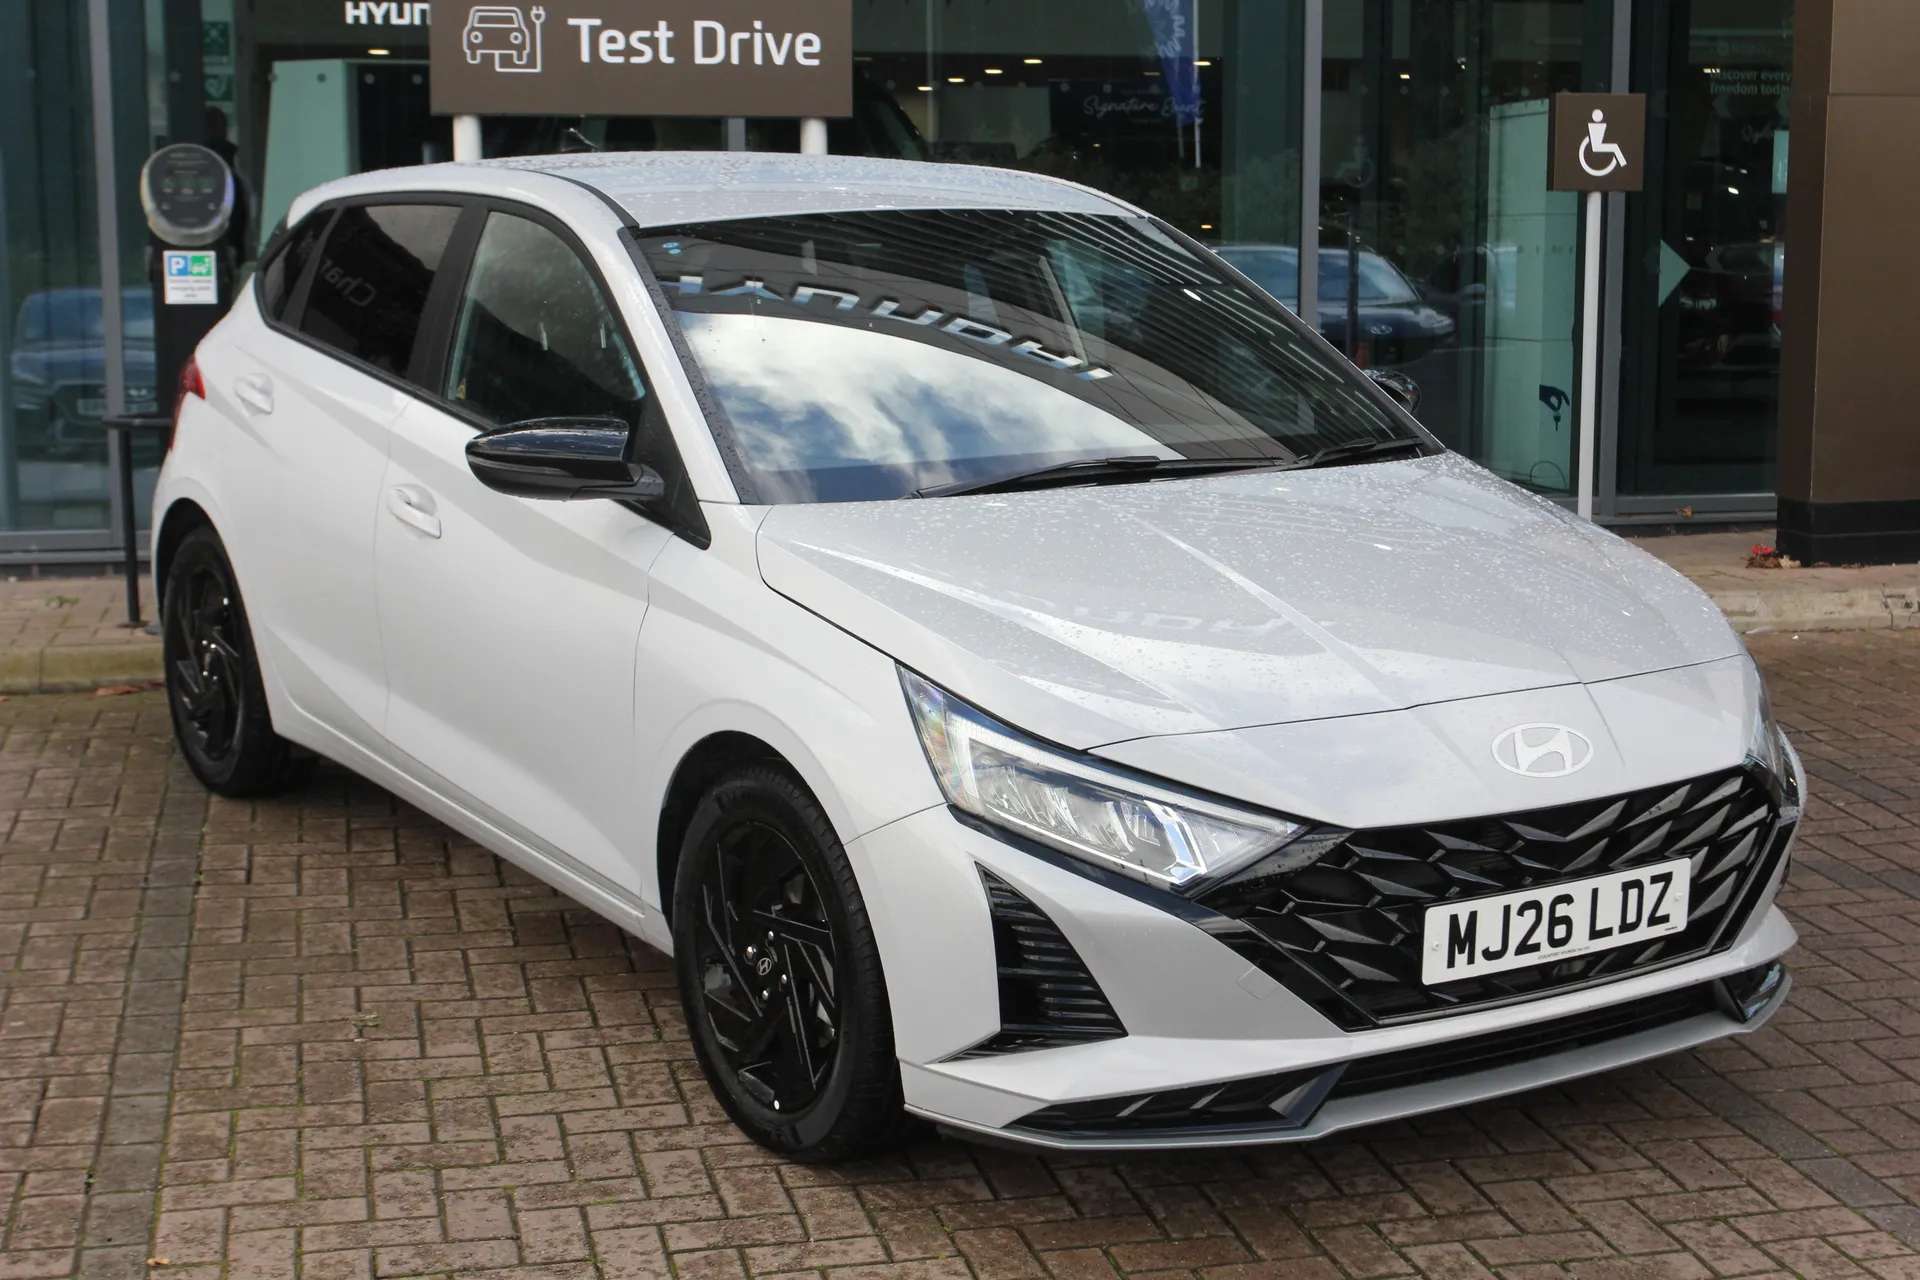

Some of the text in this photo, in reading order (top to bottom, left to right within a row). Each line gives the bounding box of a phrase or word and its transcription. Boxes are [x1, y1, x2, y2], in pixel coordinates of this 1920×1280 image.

[567, 18, 821, 66] Test Drive
[1083, 95, 1158, 119] Signature
[171, 257, 185, 275] P
[1447, 871, 1673, 969] MJ26 LDZ
